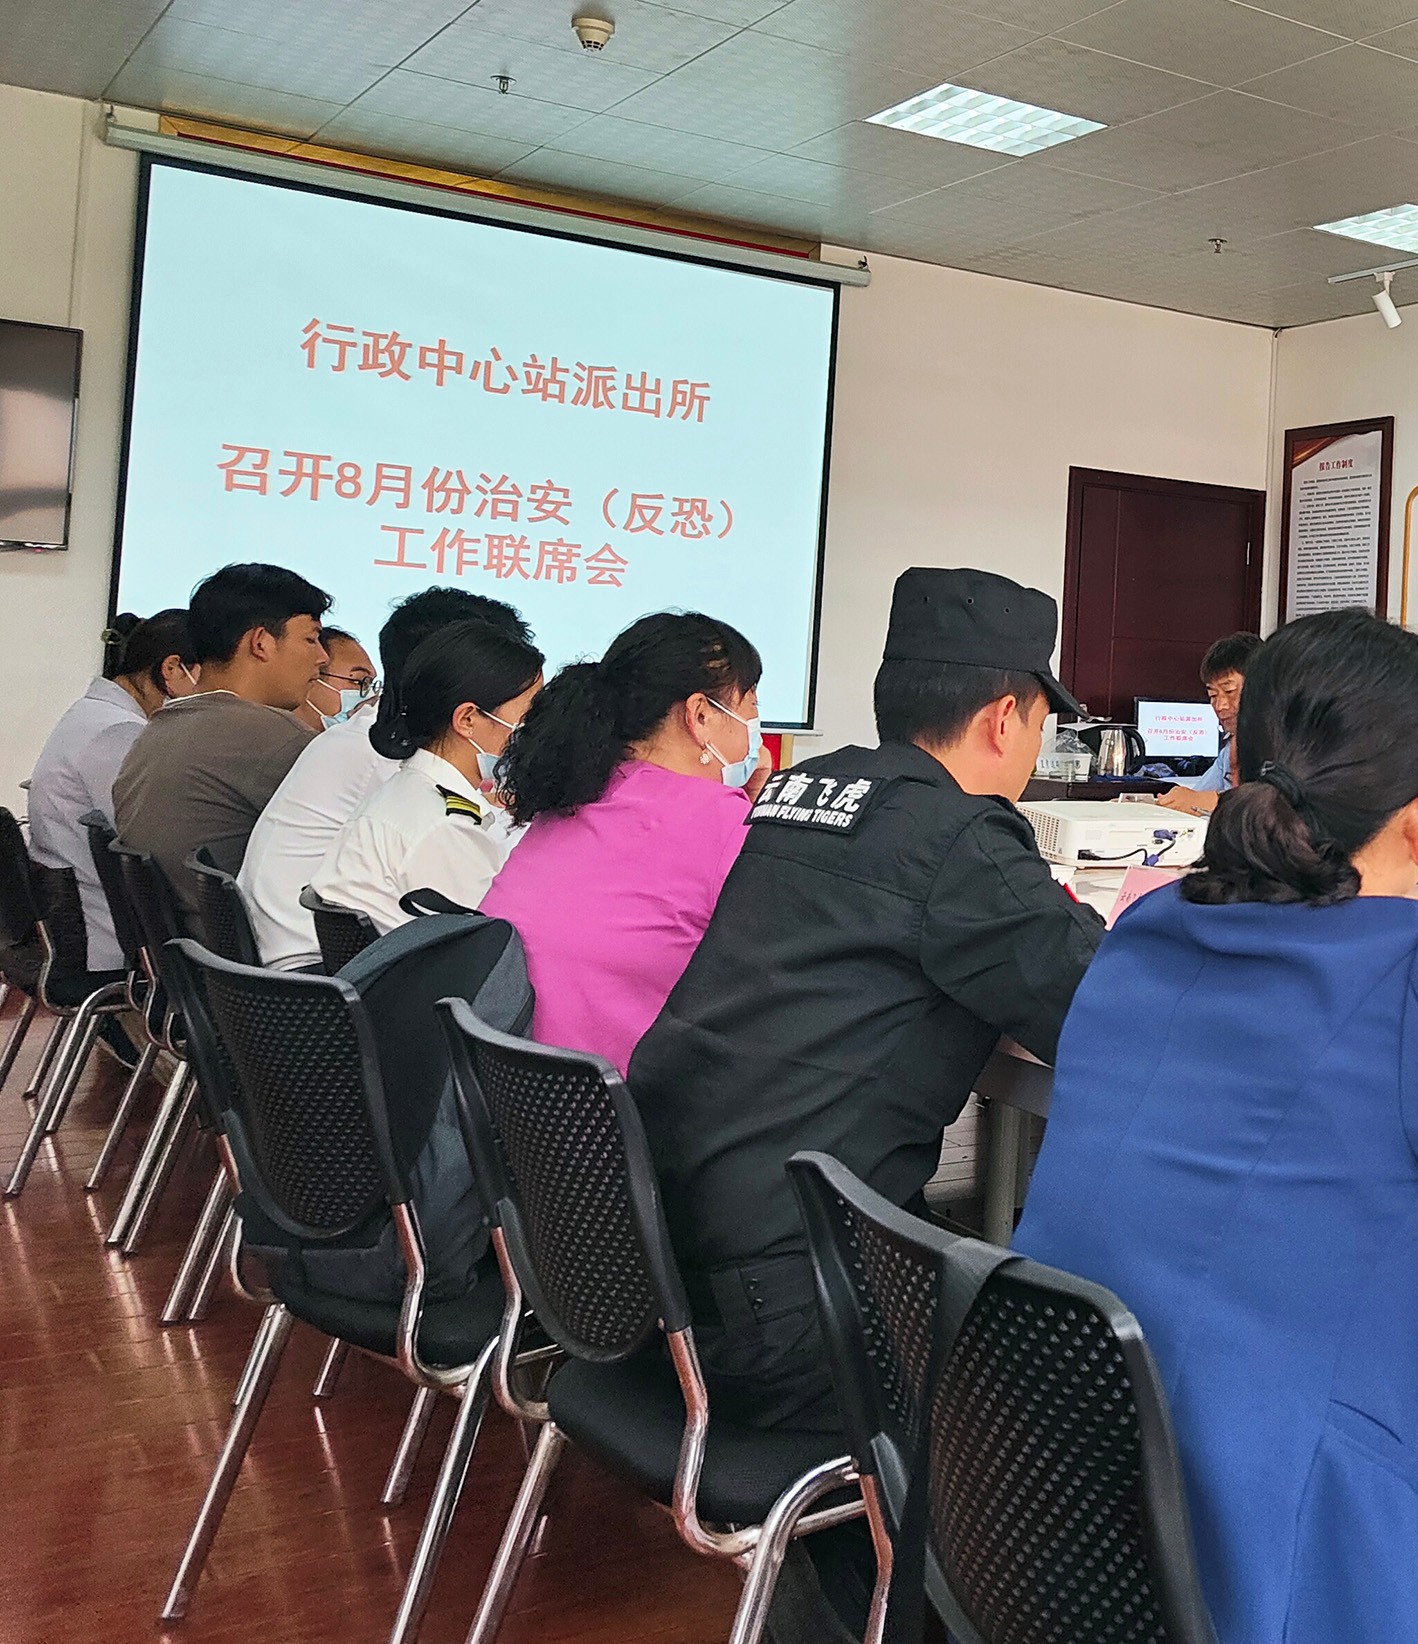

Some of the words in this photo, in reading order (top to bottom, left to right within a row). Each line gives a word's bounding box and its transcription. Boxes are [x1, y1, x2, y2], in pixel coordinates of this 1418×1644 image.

[300, 317, 711, 423] 行政中心站派出所
[373, 524, 629, 588] 工作联席会
[777, 805, 813, 822] FLYING
[812, 808, 853, 828] TIGERS
